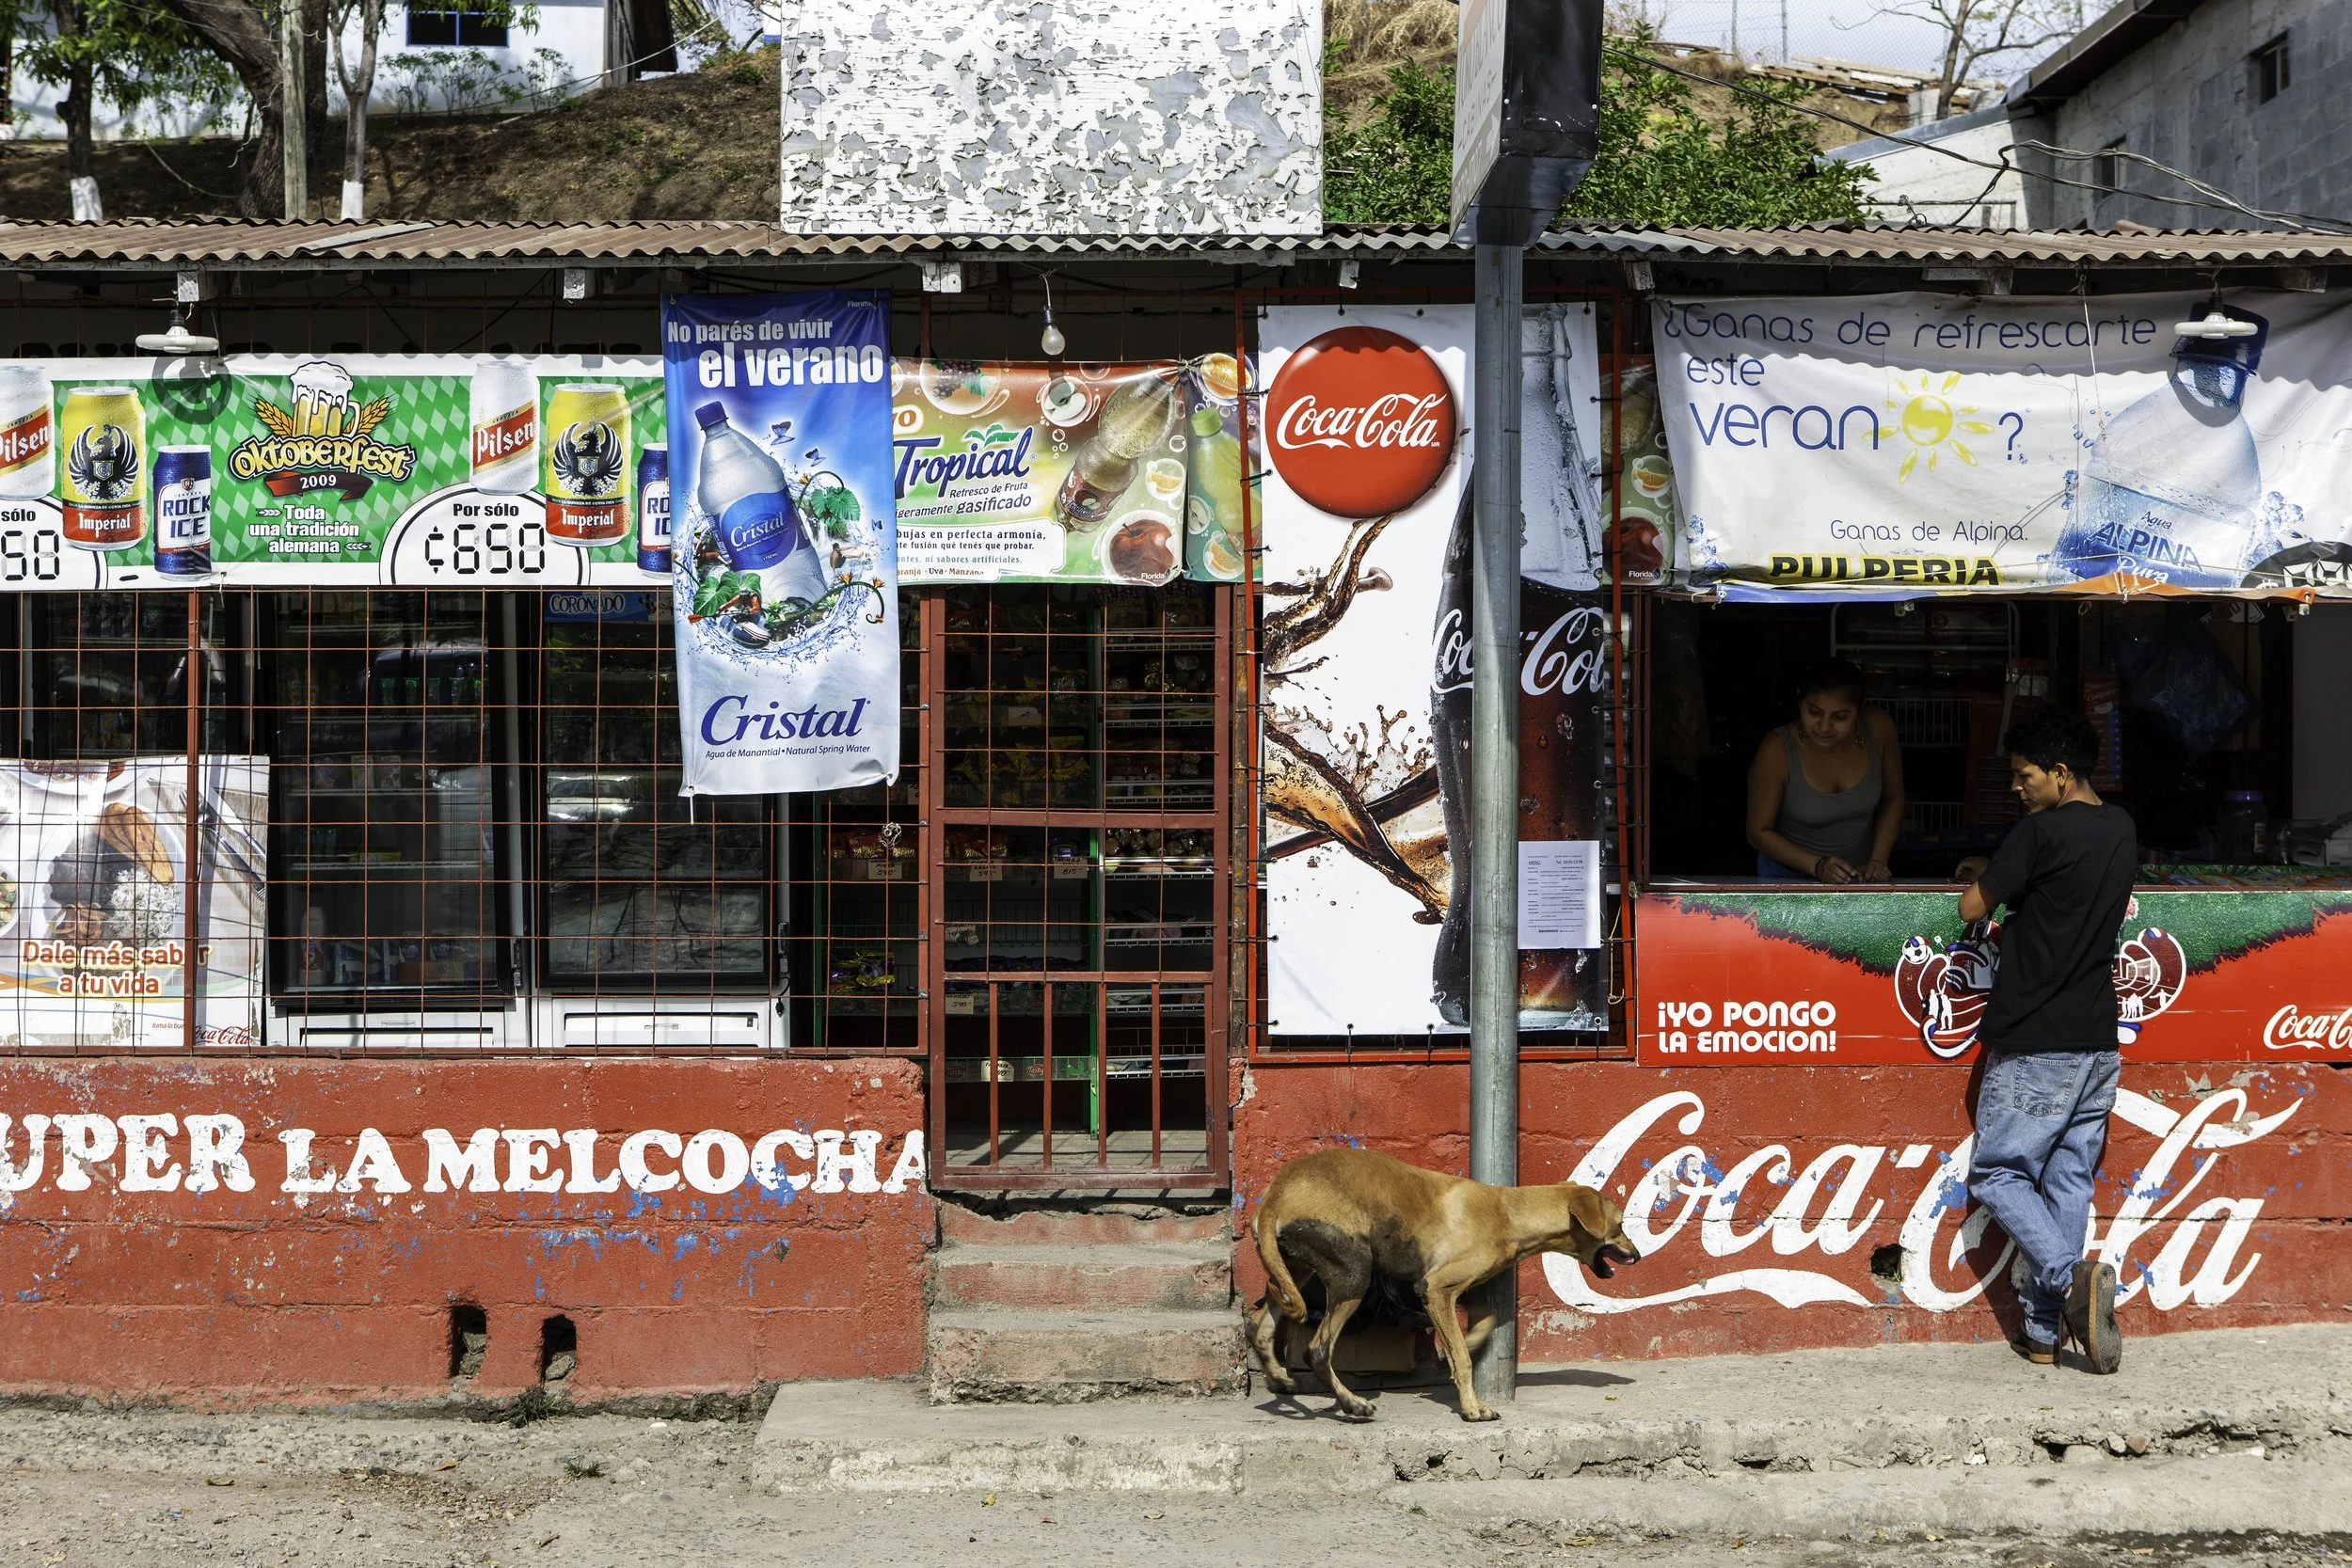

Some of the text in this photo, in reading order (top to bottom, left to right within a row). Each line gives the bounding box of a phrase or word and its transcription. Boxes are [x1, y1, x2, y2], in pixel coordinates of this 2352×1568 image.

[667, 318, 834, 344] No parés de vivir
[1664, 303, 2156, 349] ¿Ganas de refrescarte
[698, 341, 884, 388] el verano
[1687, 352, 1765, 387] este
[1277, 392, 1448, 451] Coca-Cola
[476, 420, 535, 463] Pilsen
[893, 426, 1034, 499] Tropical
[299, 474, 338, 490] 2009
[950, 482, 1028, 499] Refresco de Fruta
[1, 508, 37, 522] sólo
[164, 495, 211, 516] ROCK
[283, 504, 326, 521] Toda
[453, 502, 520, 517] Por sólo
[956, 494, 1032, 515] gasificado
[78, 512, 132, 538] Imperial
[170, 516, 206, 538] ICE
[248, 521, 360, 537] una tradición
[561, 508, 615, 534] Imperial
[730, 511, 785, 547] Cristal
[2140, 511, 2172, 530] Agua
[947, 530, 993, 542] perfecta
[996, 530, 1046, 541] armonía,
[1830, 519, 2029, 546] Ganas de Alpina.
[268, 538, 341, 553] alemana
[911, 540, 938, 549] fusión
[941, 541, 957, 551] qué
[960, 541, 982, 549] tenés
[985, 542, 1001, 551] que
[1004, 541, 1035, 551] probar.
[2090, 521, 2207, 576] ALPINA
[925, 555, 933, 563] ni
[936, 555, 969, 563] sabores
[972, 555, 1023, 563] artificiales.
[948, 567, 984, 576] Manzana
[1140, 572, 1165, 580] Florida
[1770, 555, 2001, 586] PULPERIA
[549, 594, 626, 614] CORONADO
[700, 694, 867, 747] Cristal
[706, 744, 871, 760] Agua de Manantial Natural Spring Water
[23, 941, 211, 966] Dale más sabr
[59, 973, 159, 993] a tu vida
[1658, 1000, 1836, 1028] ¡YO PONGO
[1659, 1030, 1837, 1053] LA EMOCION!
[278, 1128, 412, 1194] LA
[421, 1127, 926, 1195] MELCOCHA
